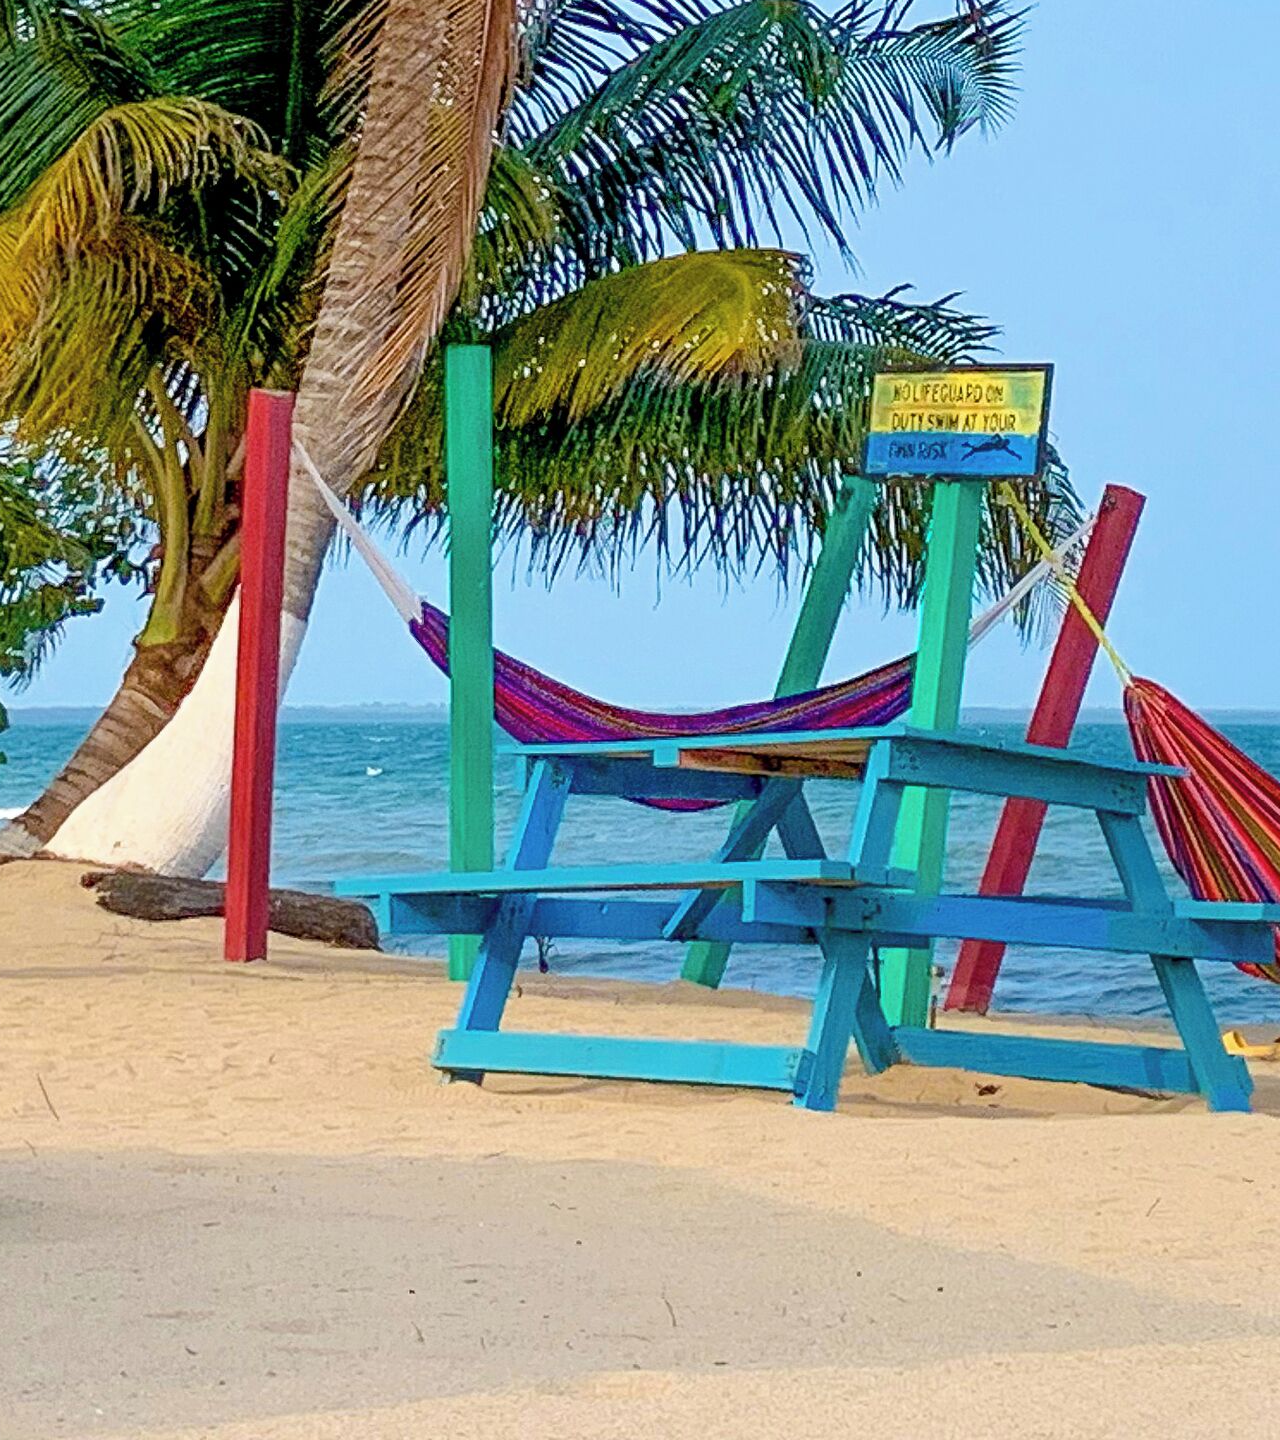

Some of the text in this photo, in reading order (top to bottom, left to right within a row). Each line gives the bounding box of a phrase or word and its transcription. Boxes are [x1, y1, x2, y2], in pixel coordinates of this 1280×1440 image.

[893, 383, 1004, 403] NO LIFEGUARD ON
[892, 412, 1016, 432] DUTY SWIM AT YOUR
